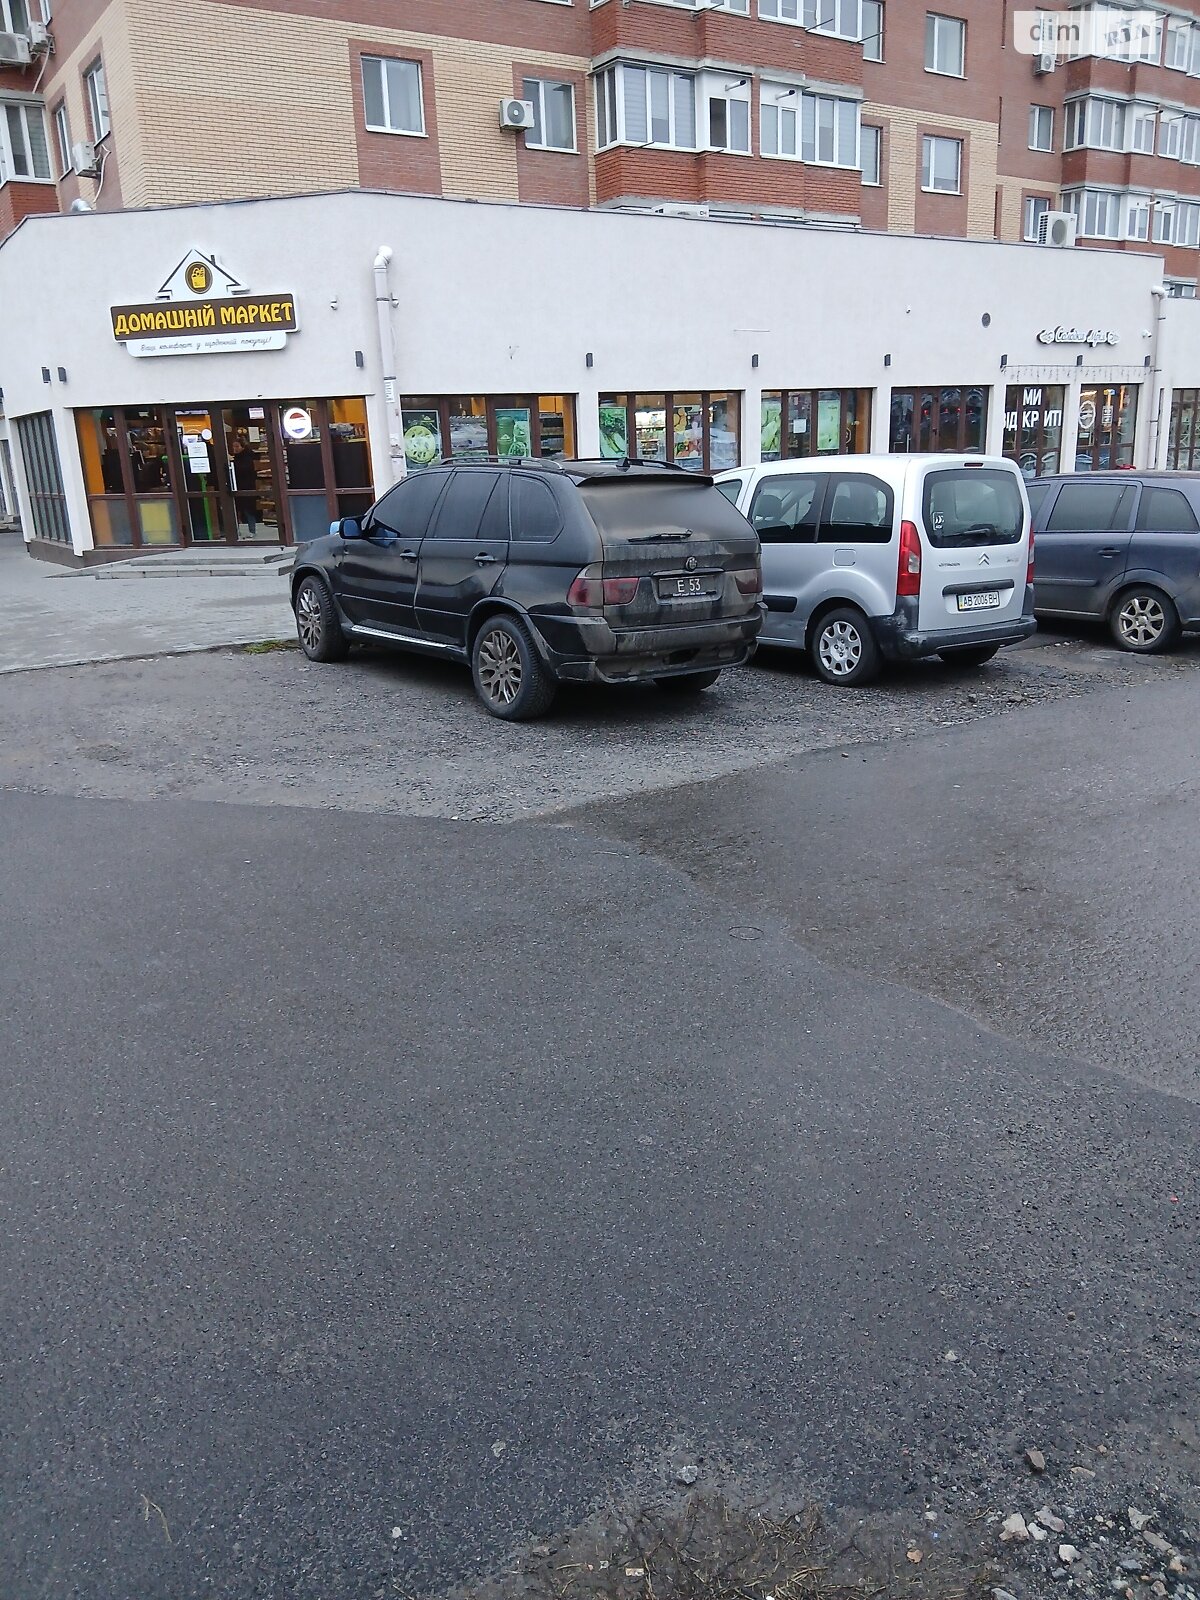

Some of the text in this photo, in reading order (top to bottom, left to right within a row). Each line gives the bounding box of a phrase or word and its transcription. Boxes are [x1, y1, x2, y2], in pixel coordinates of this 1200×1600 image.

[114, 302, 293, 336] ДОМАШНІЙ МАРКЕТ
[1022, 388, 1042, 406] МИ
[677, 578, 702, 593] E 53
